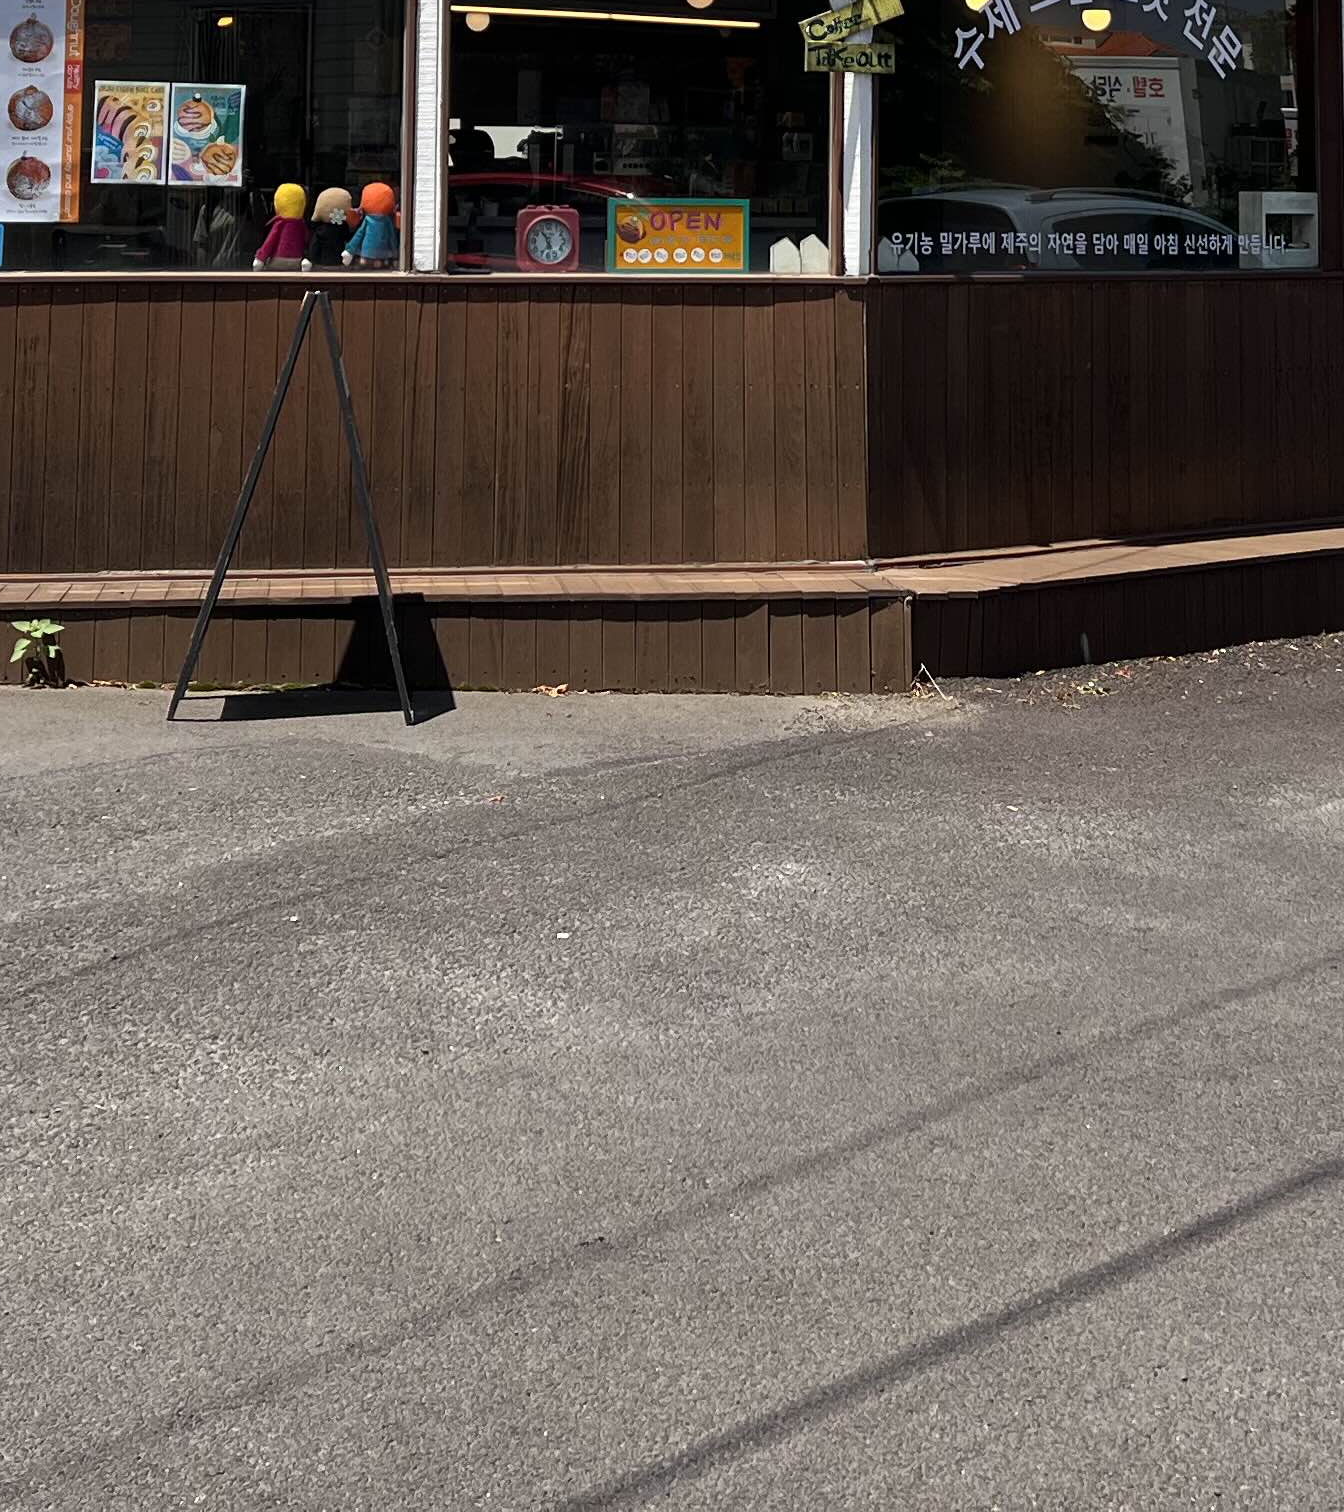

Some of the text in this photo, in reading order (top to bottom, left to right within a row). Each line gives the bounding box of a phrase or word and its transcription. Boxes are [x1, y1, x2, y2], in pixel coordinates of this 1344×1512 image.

[650, 210, 721, 231] OPEN
[890, 232, 934, 255] 유기농
[939, 232, 996, 255] 밀가루에
[1000, 232, 1042, 255] 제주의
[1047, 232, 1088, 255] 자연을
[1092, 232, 1119, 255] 담아
[1123, 232, 1149, 255] 매일
[1154, 232, 1179, 255] 아침
[1184, 232, 1233, 255] 신선하게
